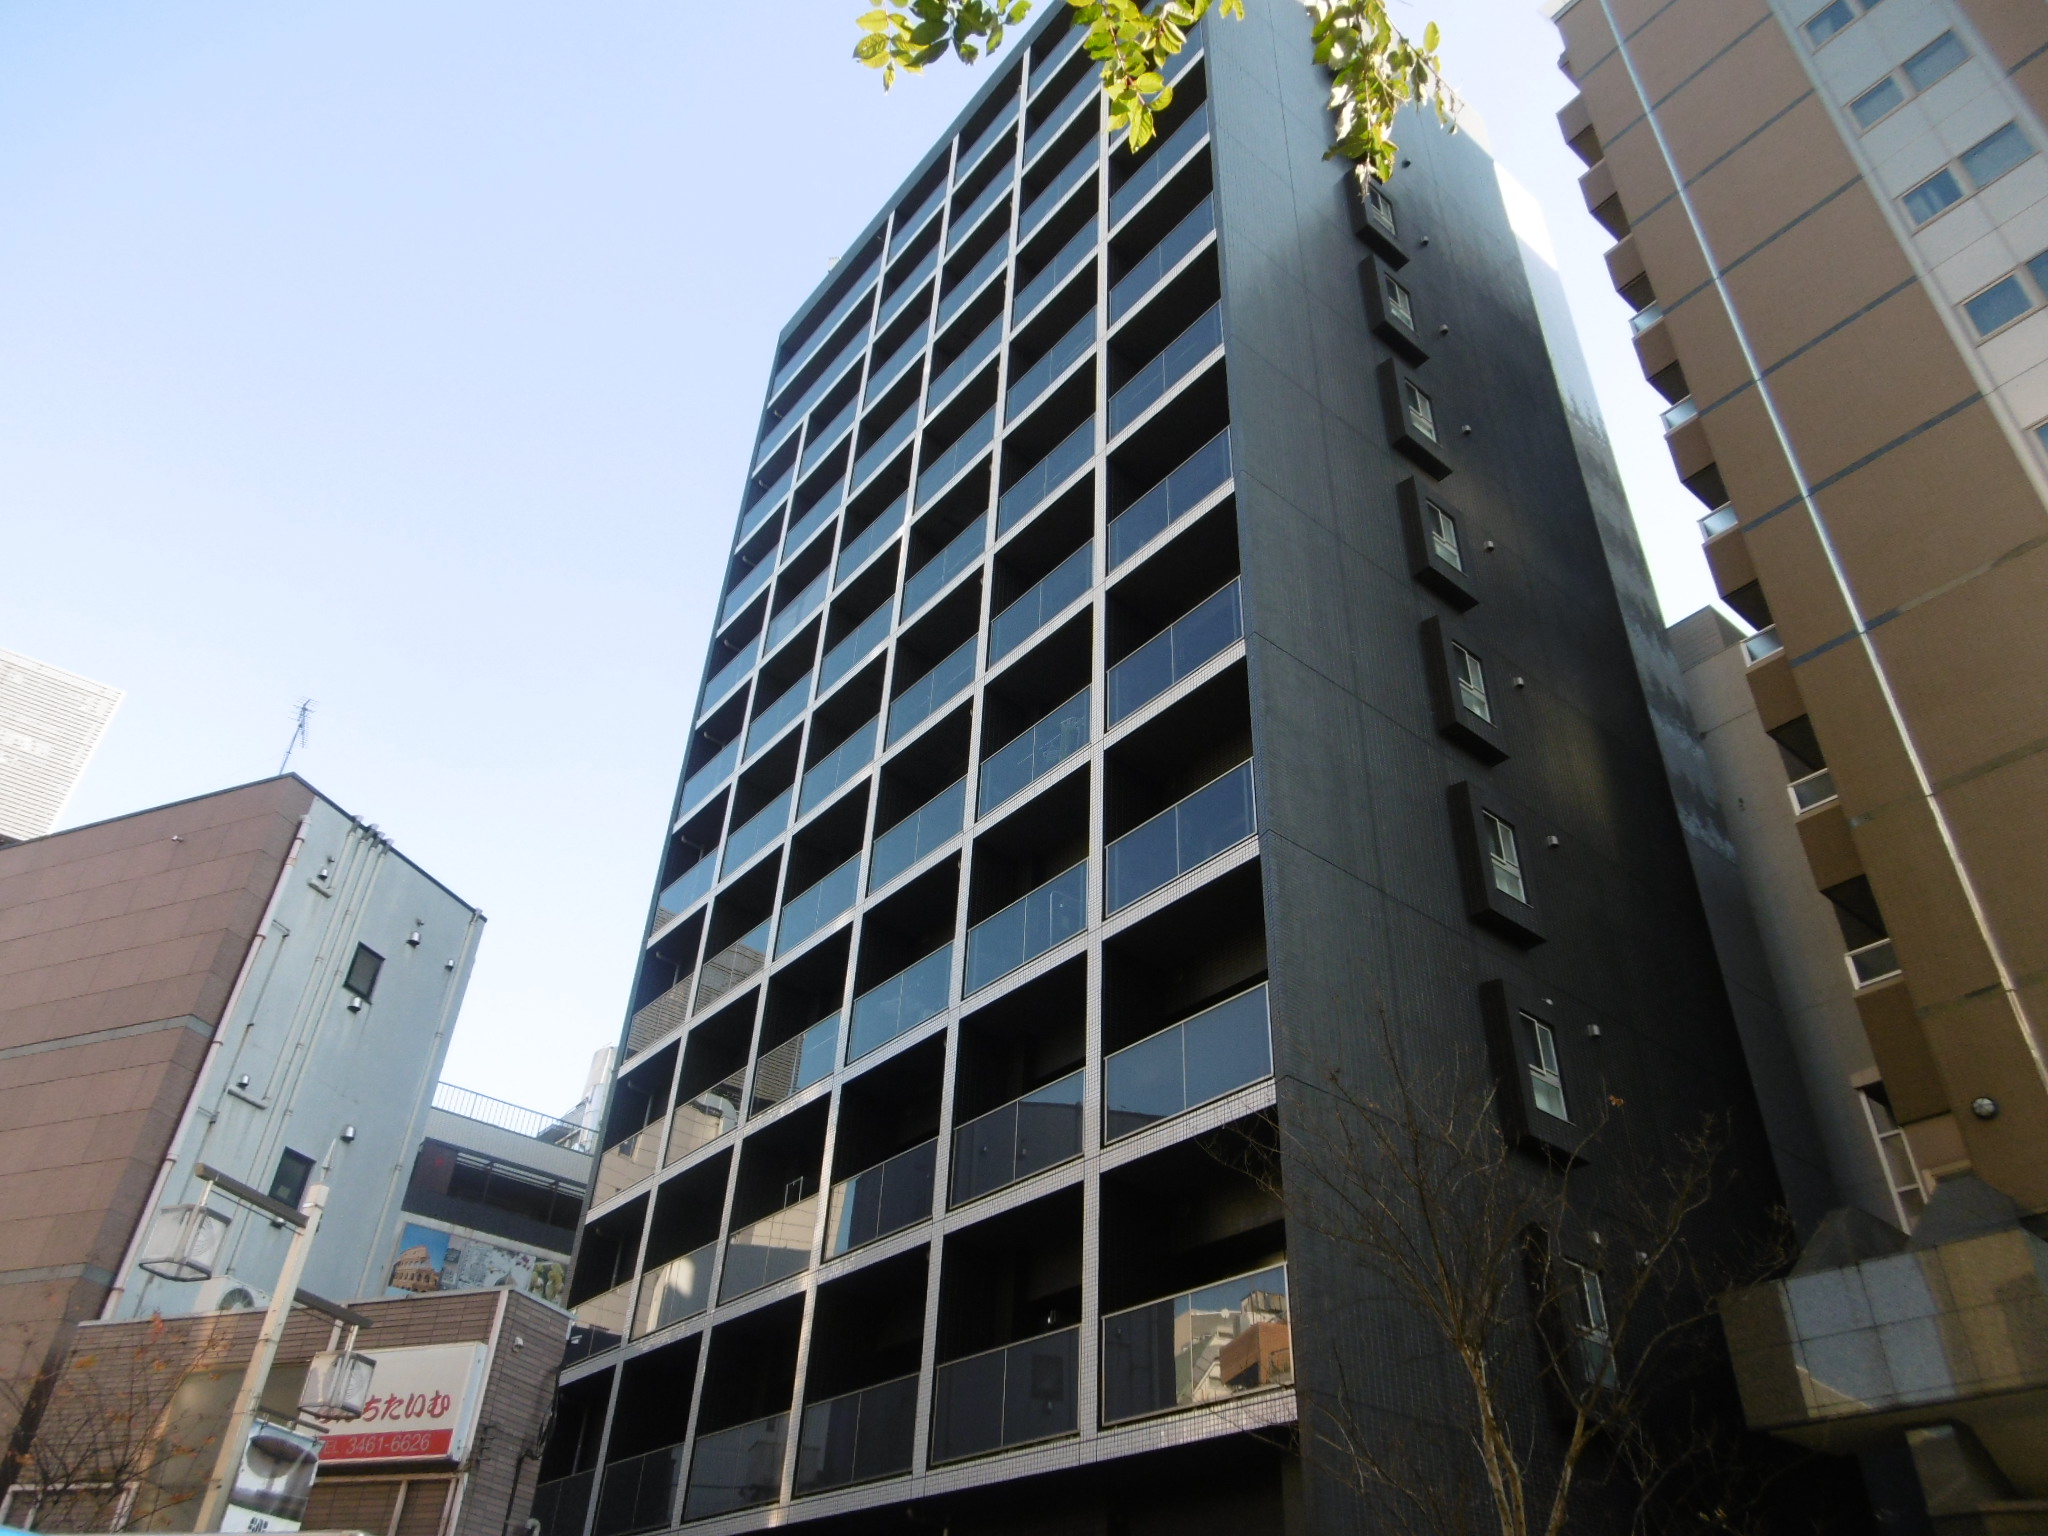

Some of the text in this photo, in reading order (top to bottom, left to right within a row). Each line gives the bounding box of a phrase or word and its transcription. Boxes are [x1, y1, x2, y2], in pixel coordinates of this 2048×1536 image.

[314, 1390, 450, 1423] ちたいむ
[346, 1433, 430, 1454] 3461-6626
